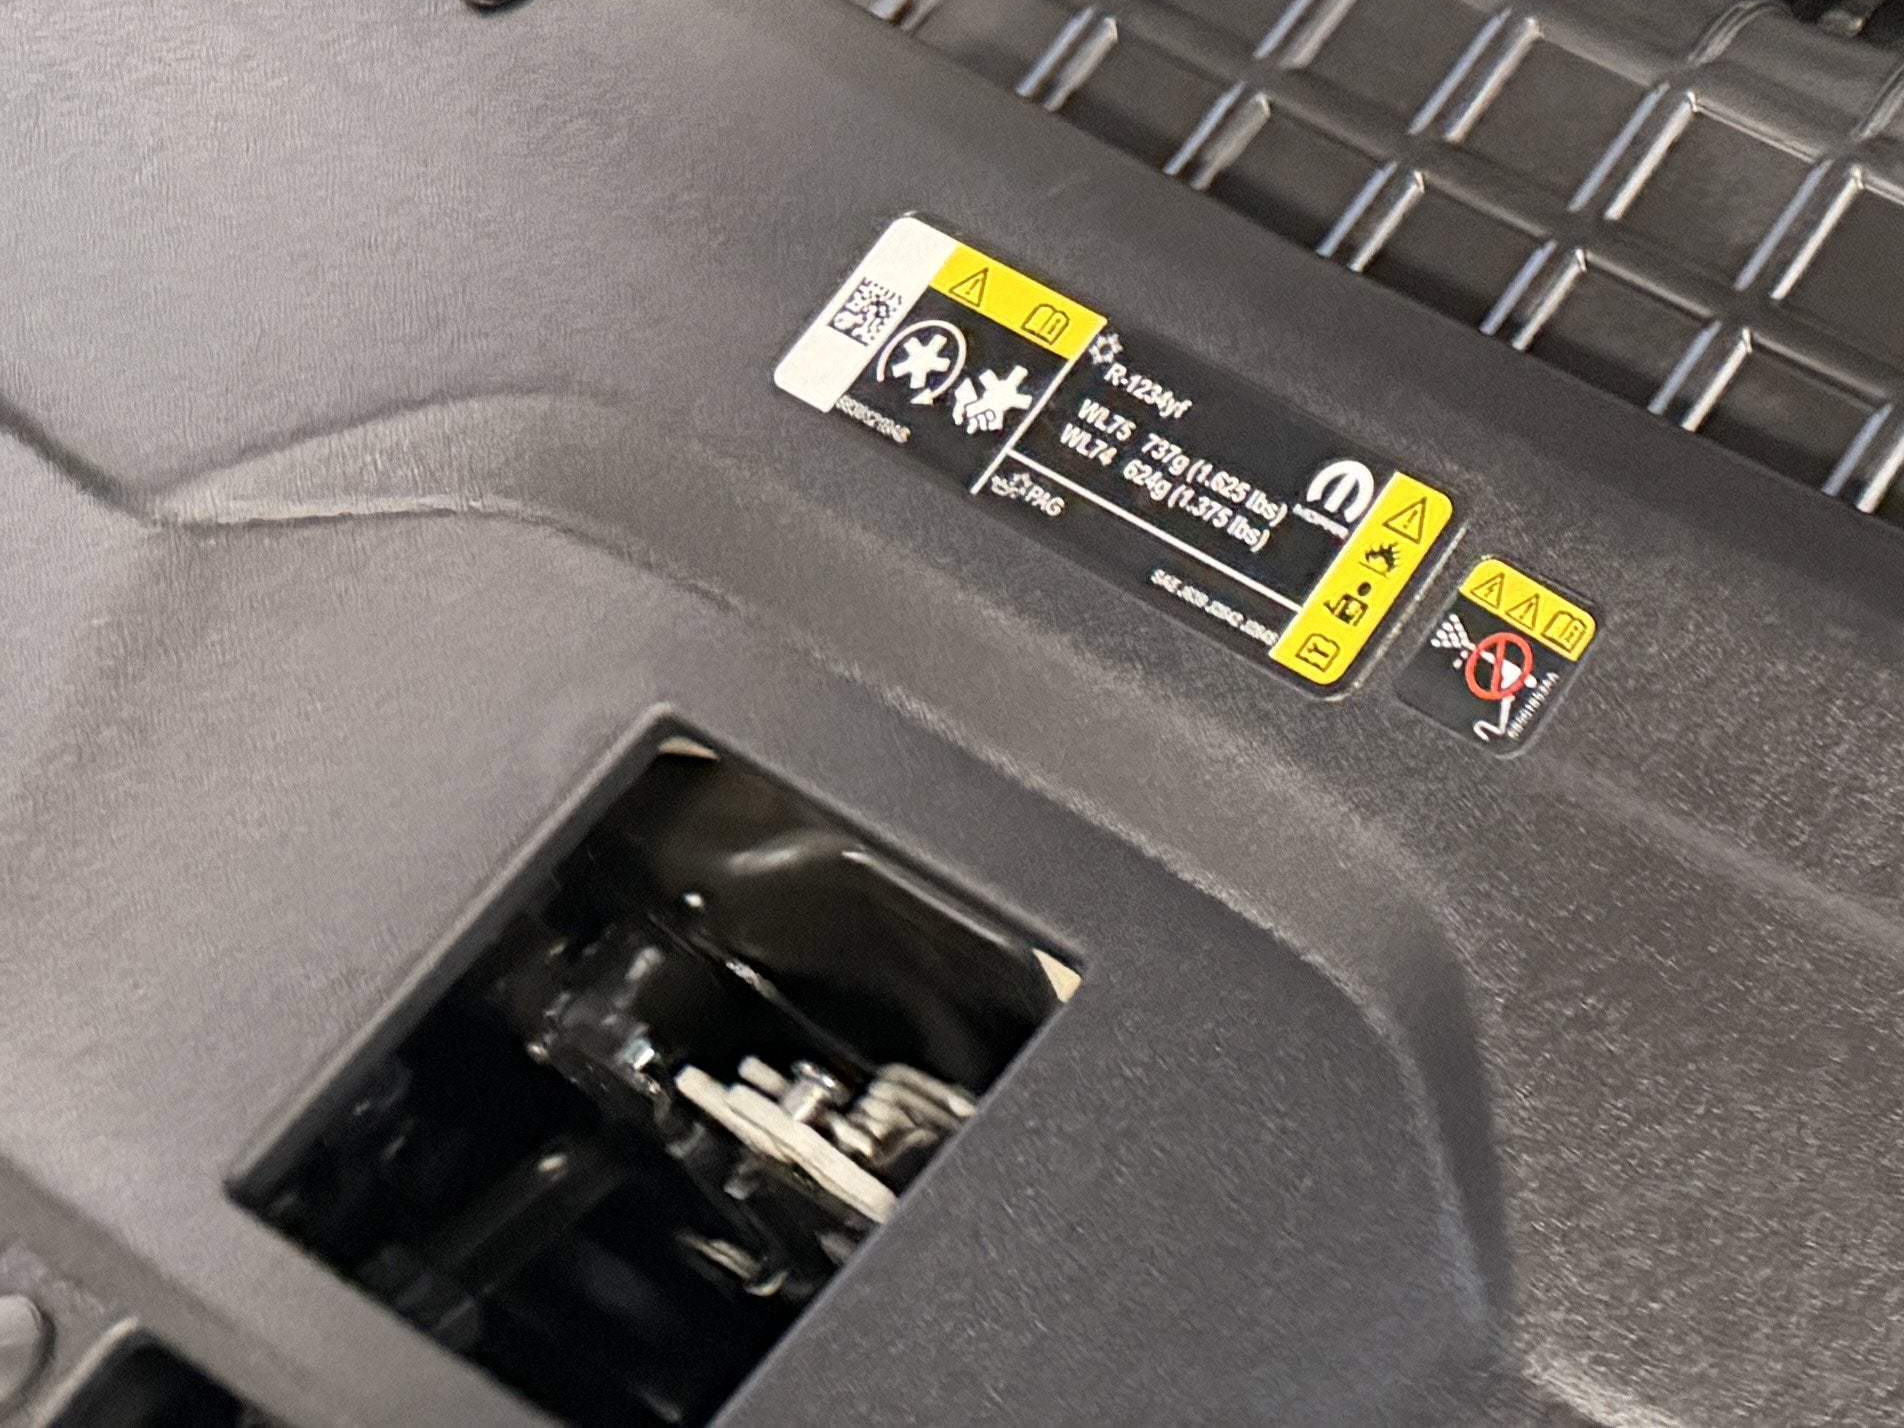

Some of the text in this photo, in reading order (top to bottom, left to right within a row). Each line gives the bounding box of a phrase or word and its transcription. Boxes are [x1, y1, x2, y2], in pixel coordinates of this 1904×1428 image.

[1104, 363, 1193, 419] R-1234yf
[1025, 485, 1066, 516] PAG
[1060, 423, 1270, 553] WL74 624g (1.375 lbs)
[1077, 398, 1288, 527] WL75 737g (1.625 lbs)
